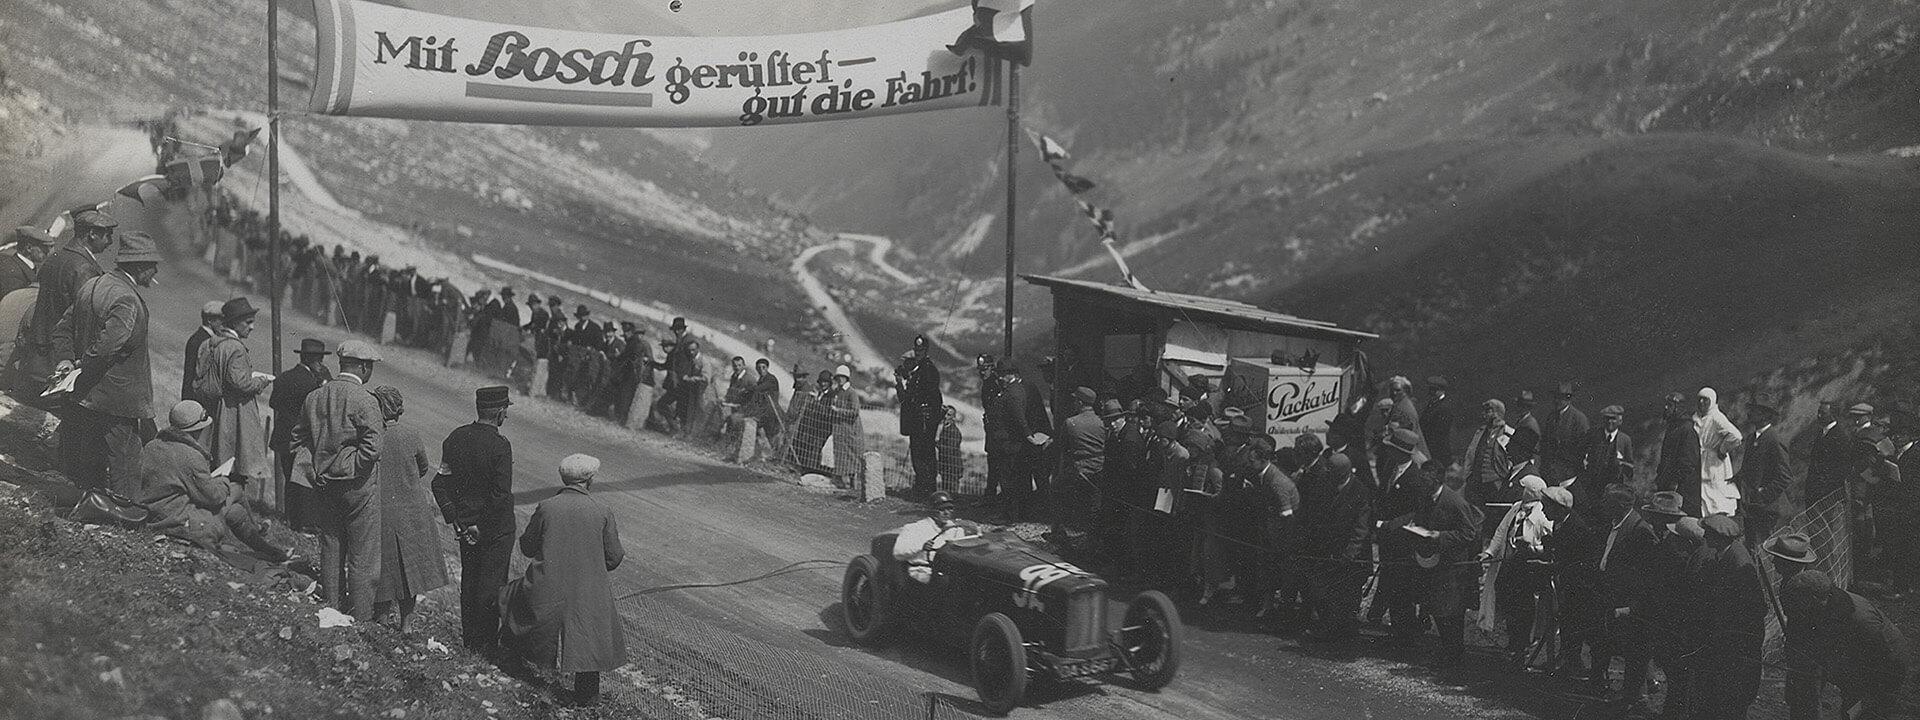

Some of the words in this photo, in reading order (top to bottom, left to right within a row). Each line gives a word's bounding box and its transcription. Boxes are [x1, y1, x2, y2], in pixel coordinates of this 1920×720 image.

[373, 30, 459, 74] Mit
[464, 30, 656, 88] Bosch
[738, 85, 807, 127] gut
[810, 77, 876, 117] die
[881, 54, 978, 109] Fahrt!
[1267, 380, 1340, 422] Packard
